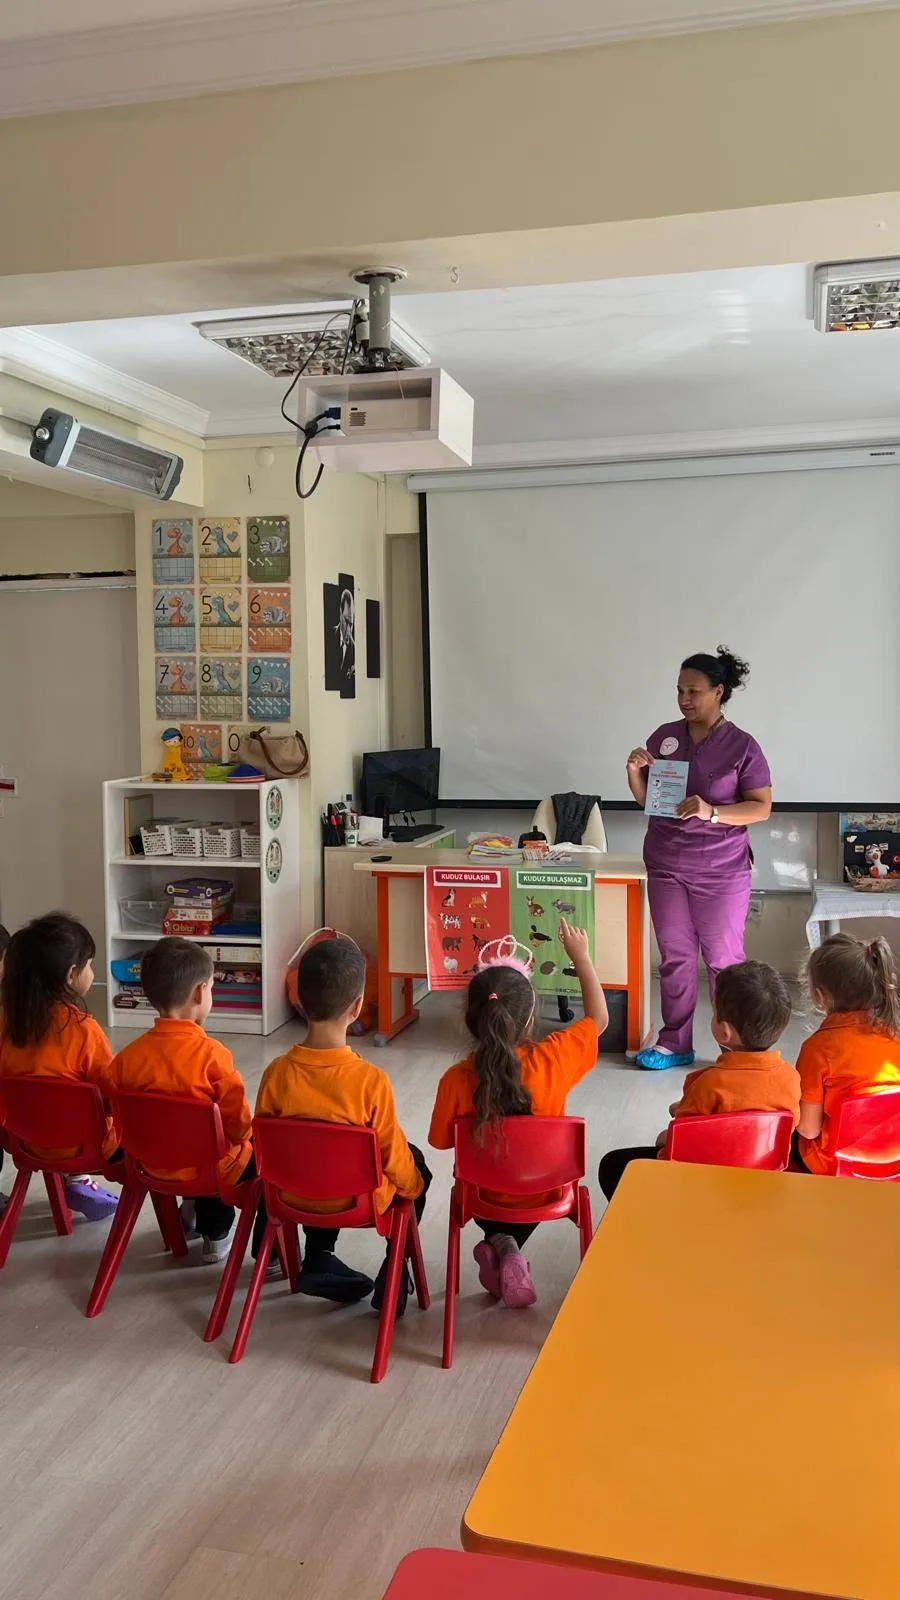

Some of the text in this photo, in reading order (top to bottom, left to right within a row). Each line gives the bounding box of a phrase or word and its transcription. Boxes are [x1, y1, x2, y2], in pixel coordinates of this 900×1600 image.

[155, 526, 162, 546] 1
[201, 526, 211, 546] 2
[249, 524, 260, 545] 3
[155, 595, 168, 615] 4
[202, 595, 212, 615] 5
[250, 594, 261, 614] 6
[160, 664, 169, 684] 7
[201, 663, 211, 683] 8
[252, 665, 261, 685] 9
[183, 735, 195, 749] 10
[228, 733, 240, 752] 0
[464, 874, 490, 882] BULAŞIR
[546, 876, 582, 885] BULAŞMAZ
